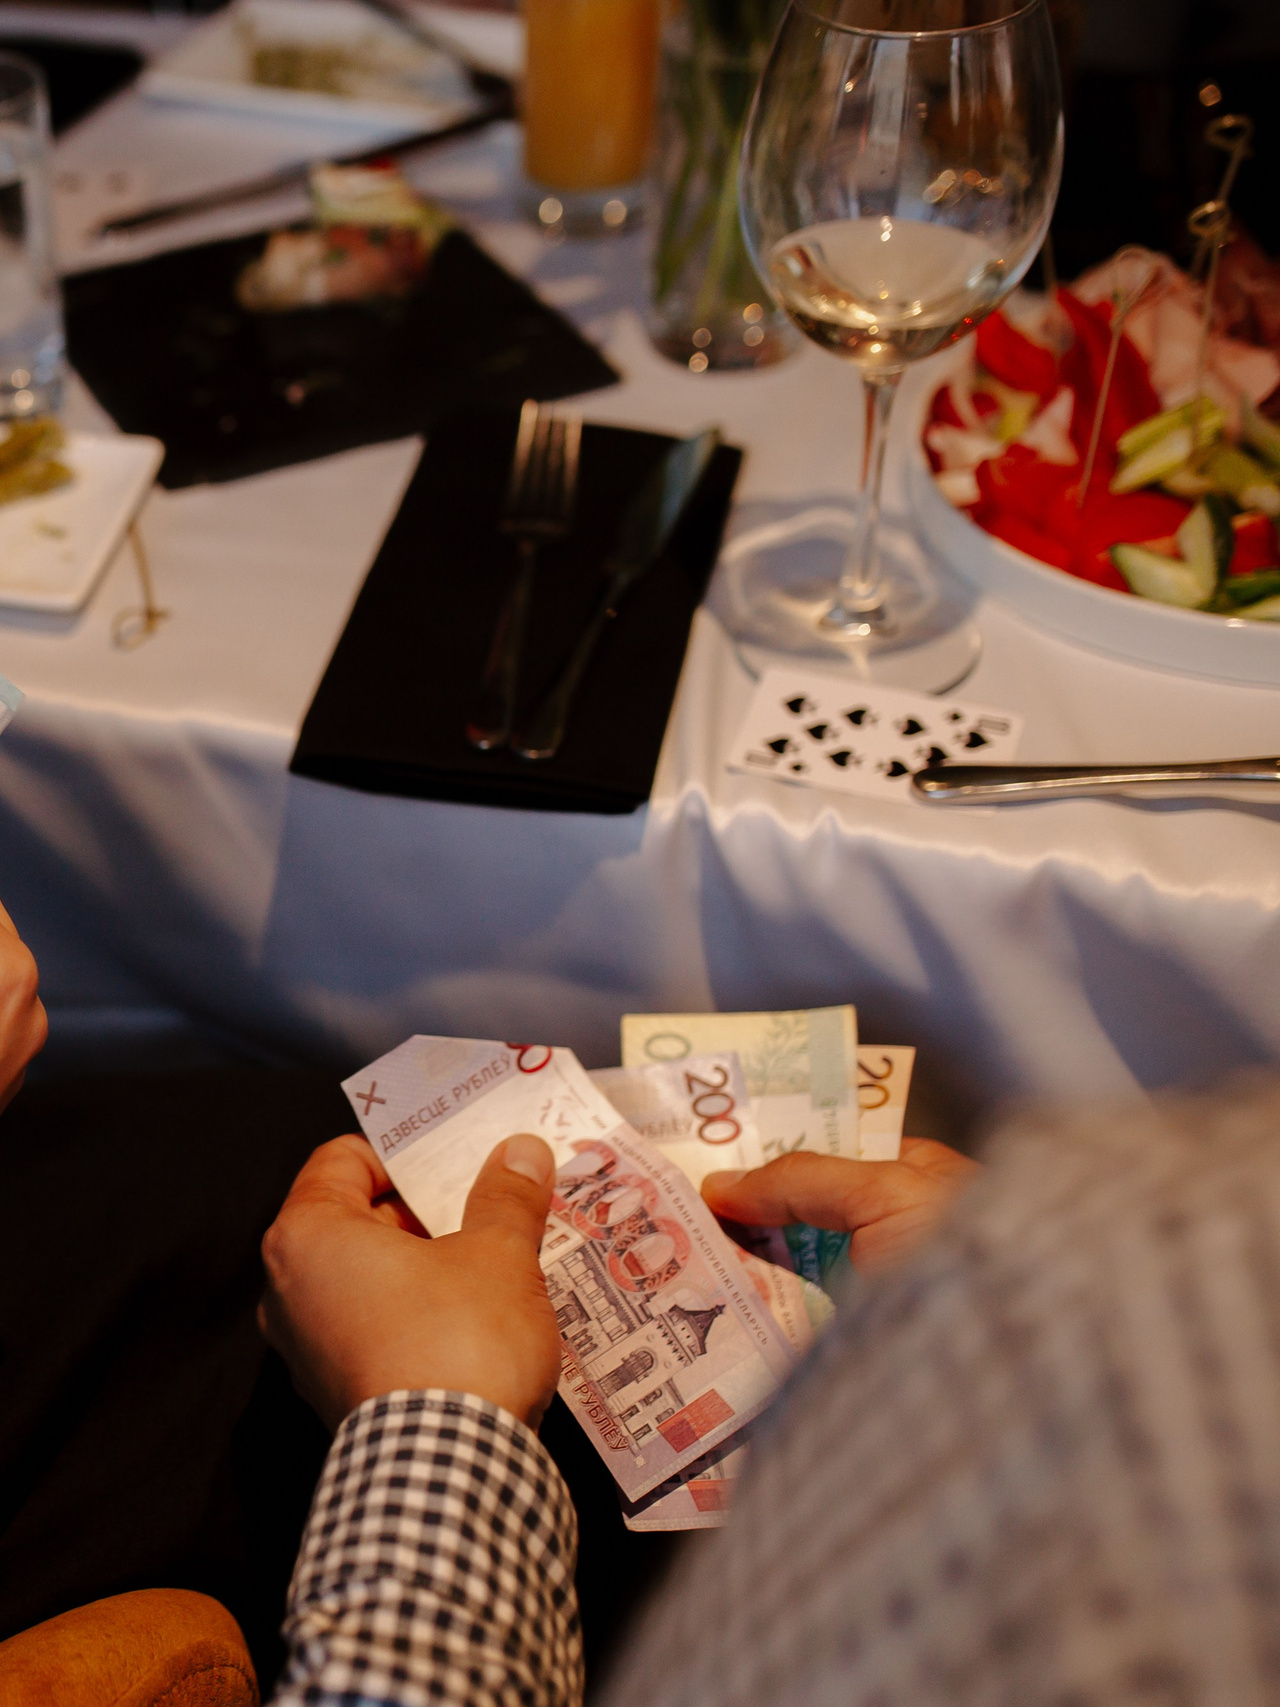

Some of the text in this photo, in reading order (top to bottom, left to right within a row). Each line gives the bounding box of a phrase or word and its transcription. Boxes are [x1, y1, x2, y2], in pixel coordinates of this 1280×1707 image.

[684, 1065, 742, 1145] 200
[858, 1055, 894, 1110] 20
[378, 1096, 450, 1154] ДЗВЕСЦЕ
[672, 1194, 696, 1226] БАНК
[691, 1225, 734, 1291] РЭСПУБЛІКІ
[731, 1291, 769, 1347] БЕЛАРУСЬ
[573, 1382, 630, 1453] РУБЛЁЎ
